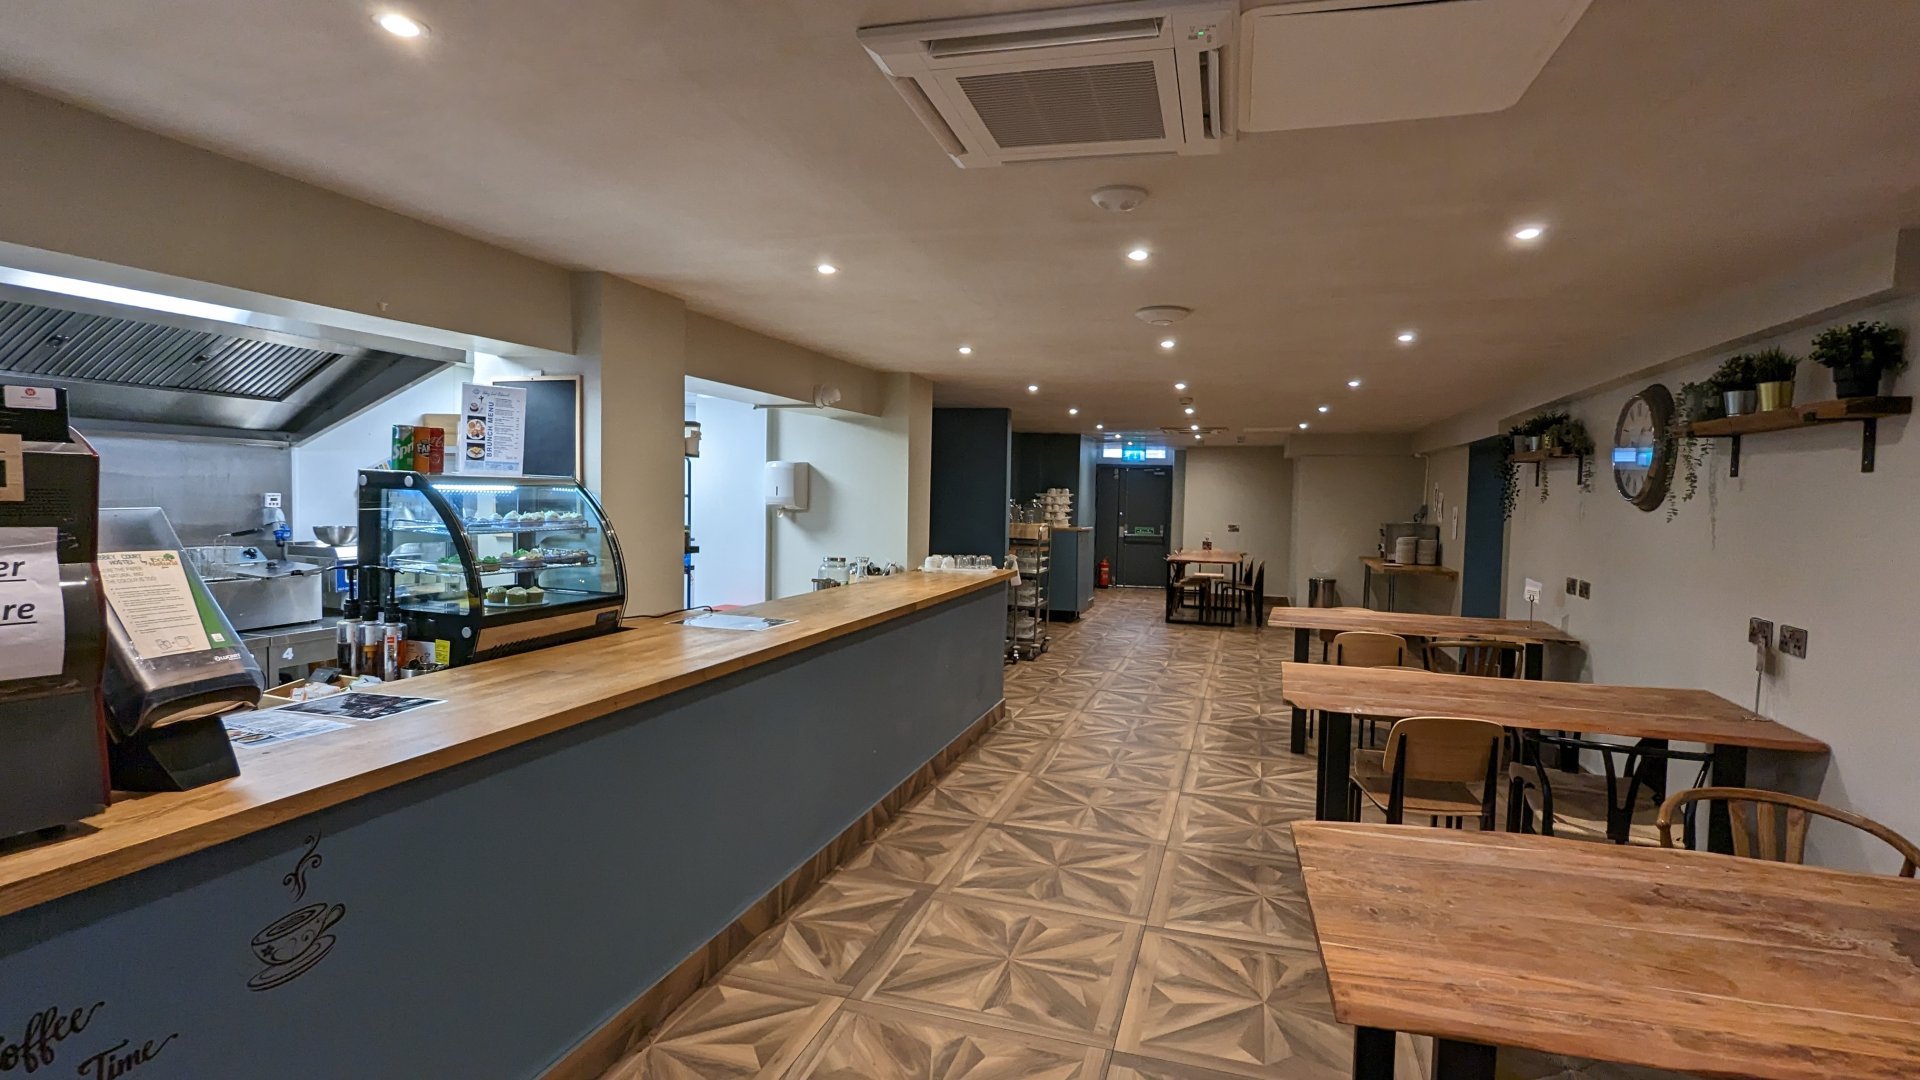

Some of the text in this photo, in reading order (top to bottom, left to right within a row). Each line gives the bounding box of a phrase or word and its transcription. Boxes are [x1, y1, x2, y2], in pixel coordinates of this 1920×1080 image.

[487, 401, 495, 424] MENU
[282, 647, 294, 660] 4
[0, 1001, 105, 1073] offee
[77, 1033, 179, 1080] Time
